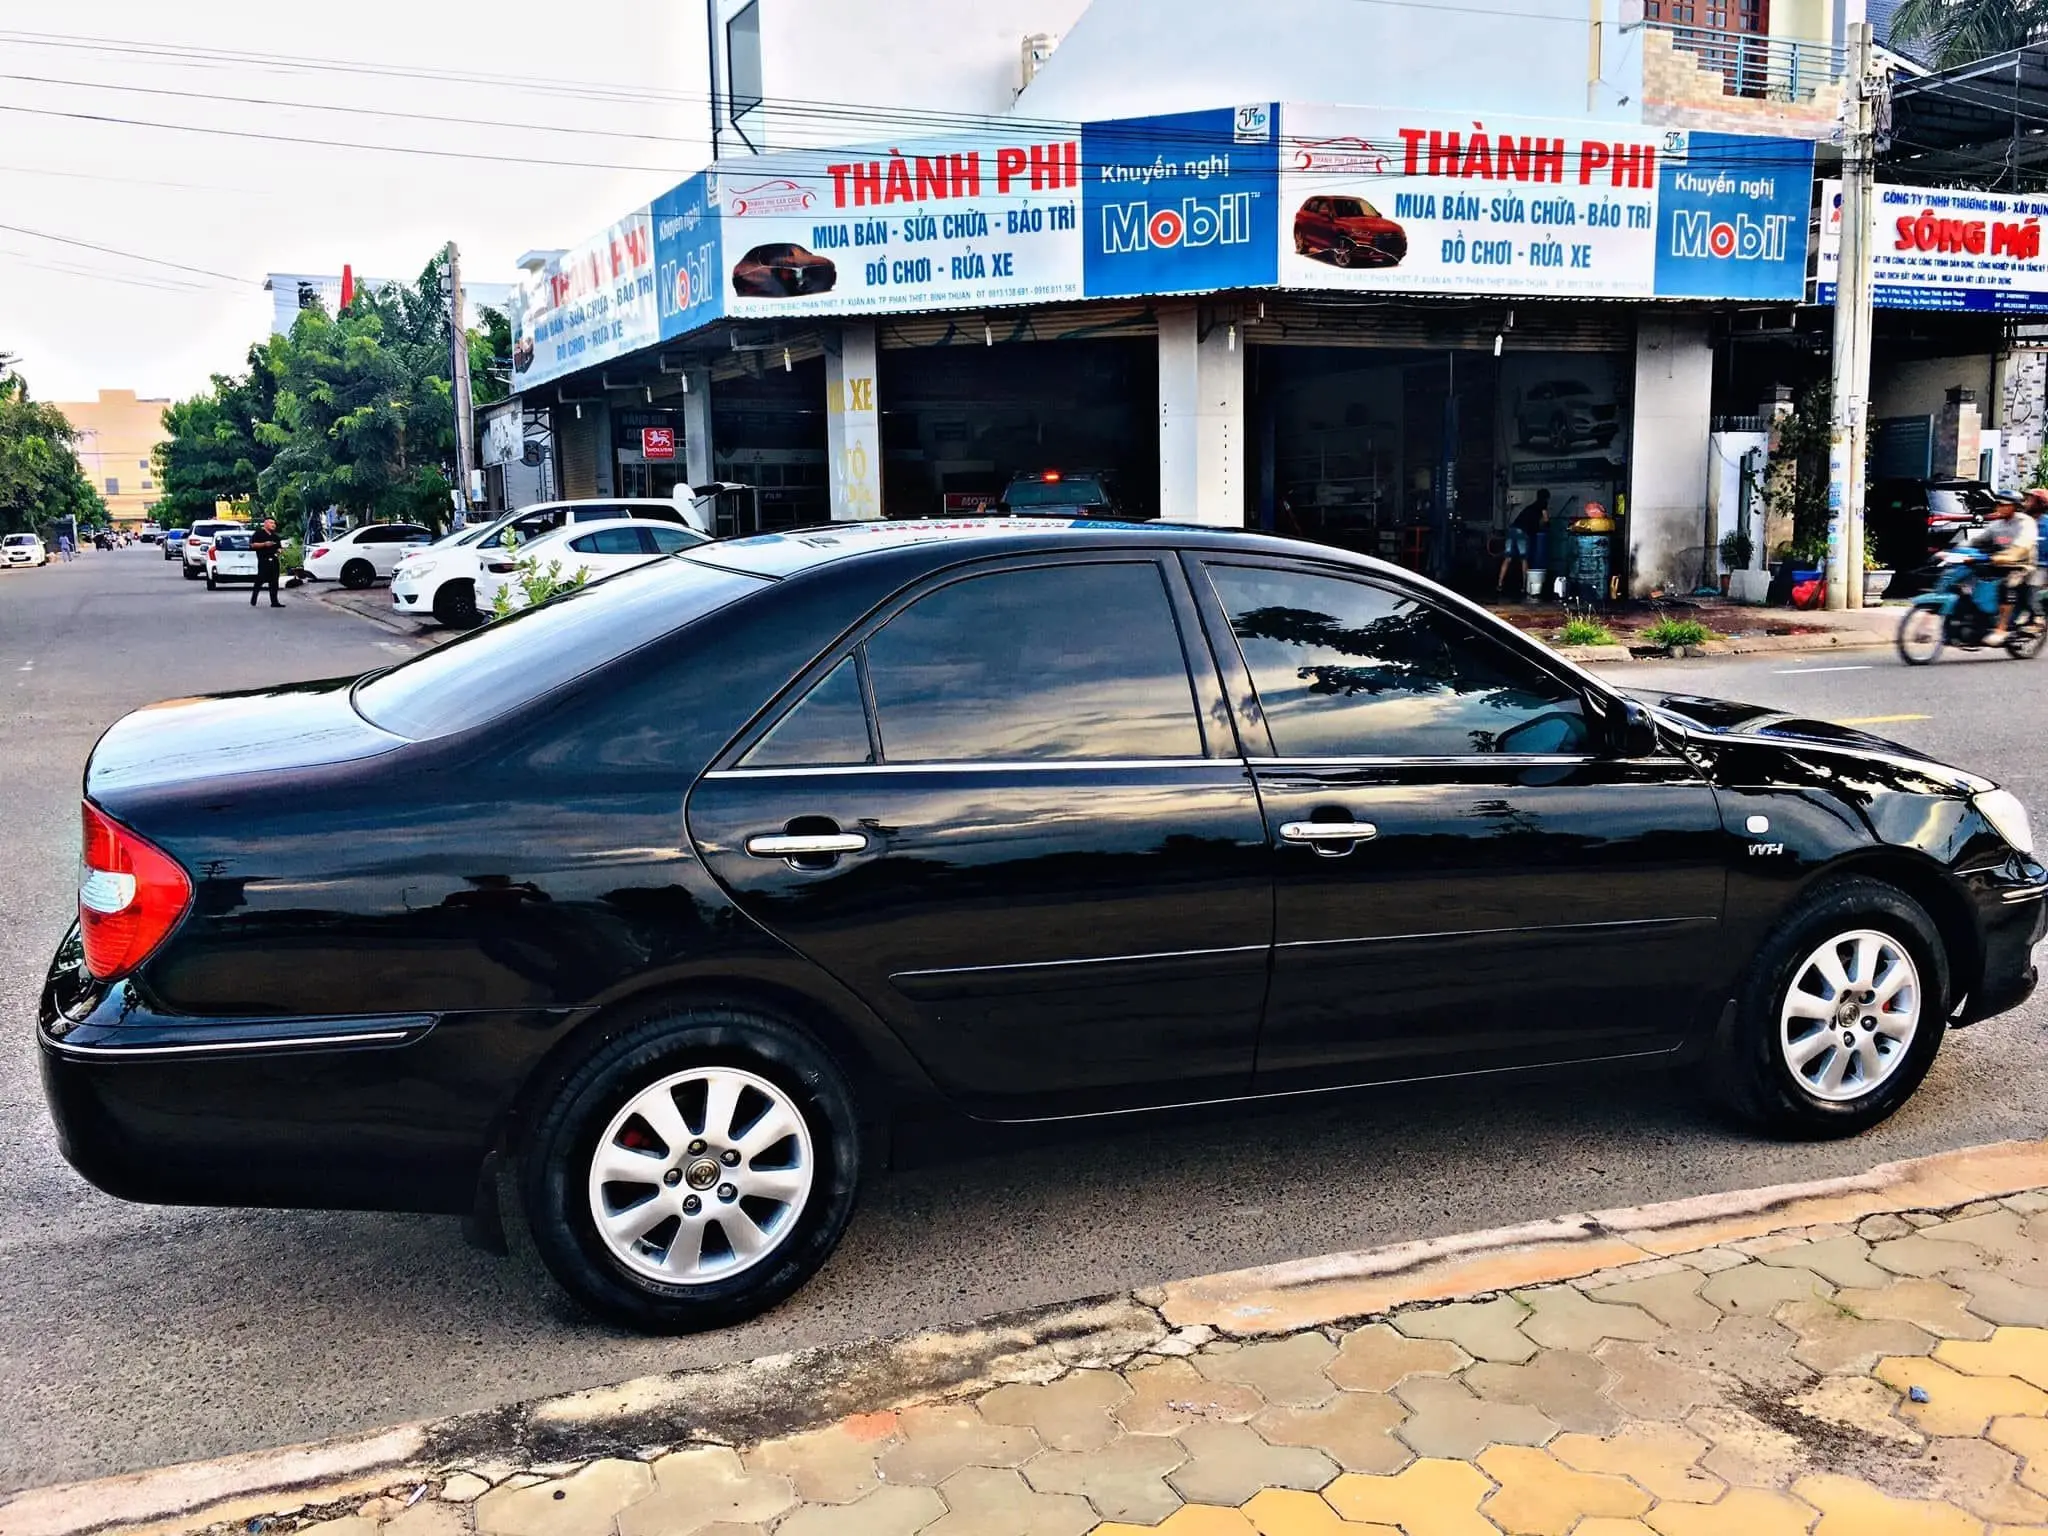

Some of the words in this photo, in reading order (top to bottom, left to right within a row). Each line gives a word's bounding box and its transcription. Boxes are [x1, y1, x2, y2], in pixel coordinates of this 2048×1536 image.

[827, 147, 980, 209] THÀNH
[997, 140, 1077, 194] PHI
[1101, 154, 1177, 184] Khuyến
[1184, 152, 1230, 179] nghị
[1399, 120, 1564, 184] THÀNH
[1579, 140, 1655, 190] PHI
[1674, 171, 1737, 197] Khuyến
[1740, 175, 1775, 200] nghị
[1883, 190, 1909, 205] CÔNG
[1911, 193, 1923, 205] TY
[1925, 194, 1949, 208] TNHH
[812, 224, 850, 250] MUA
[854, 216, 887, 247] BÁN
[903, 207, 938, 244] SỬA
[943, 208, 988, 240] CHỮA
[1007, 200, 1043, 234] BẢO
[1048, 200, 1076, 231] TRÌ
[1103, 192, 1250, 254] Mobil
[1395, 193, 1436, 220] MUA
[1442, 190, 1481, 221] BÁN
[1491, 189, 1525, 224] SỬA
[1531, 195, 1576, 226] CHỮA
[1588, 195, 1622, 228] BẢO
[1627, 201, 1652, 230] TRÌ
[1441, 230, 1466, 264] ĐỒ
[1471, 238, 1511, 265] CHƠI
[1530, 233, 1563, 268] RỬA
[1571, 244, 1592, 269] XE
[1672, 210, 1788, 262] Mobil
[865, 255, 888, 287] ĐỒ
[893, 257, 932, 284] CHƠI
[951, 245, 985, 280] RỬA
[992, 252, 1013, 277] XE
[612, 319, 624, 338] XE
[850, 378, 873, 411] XE
